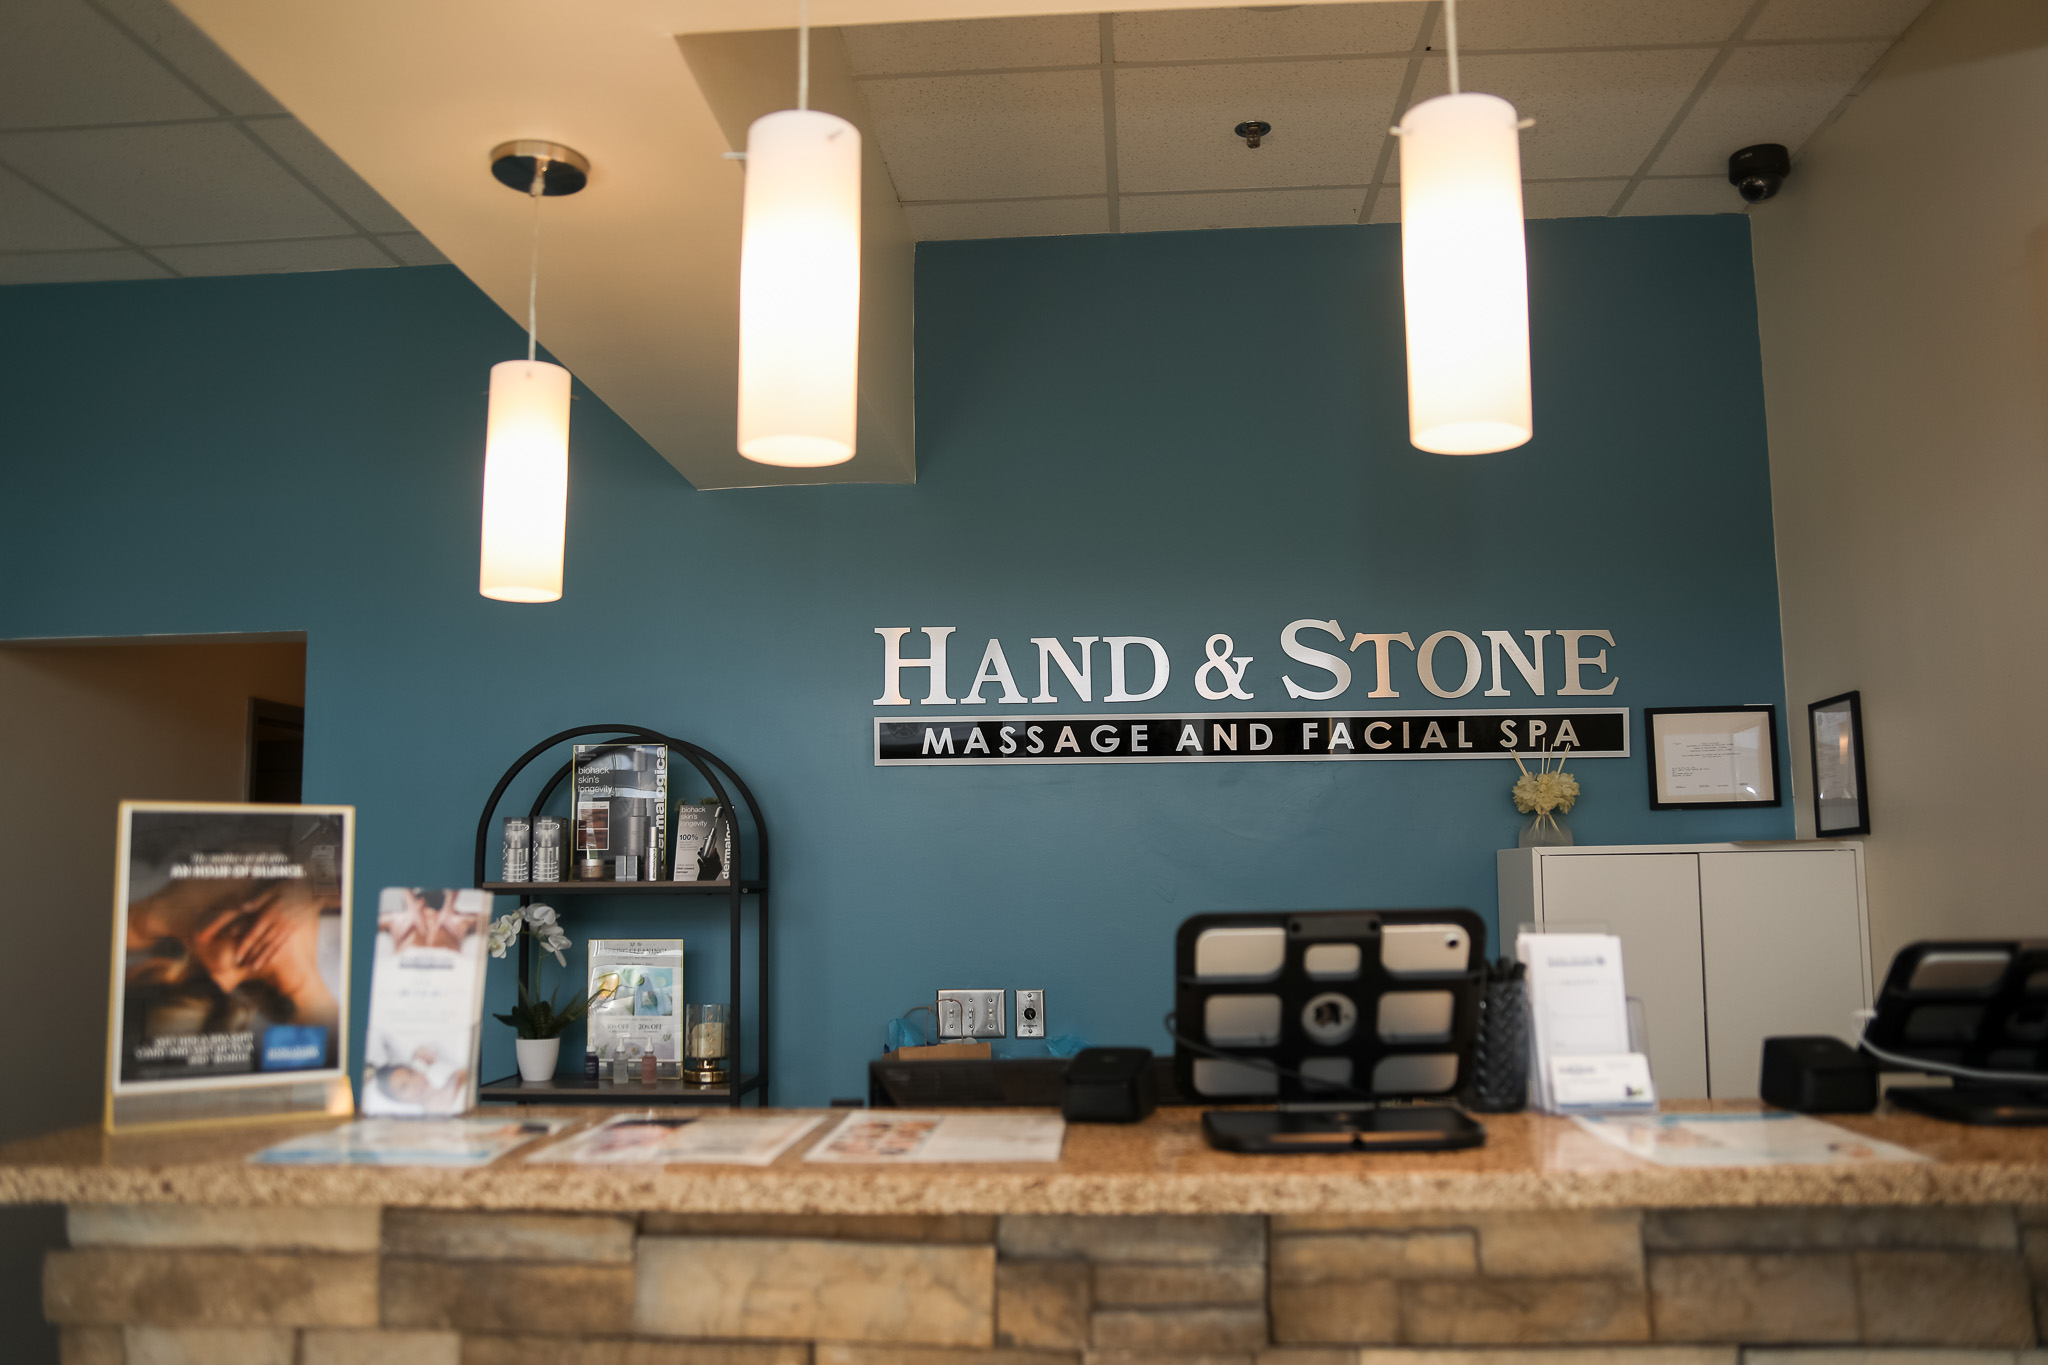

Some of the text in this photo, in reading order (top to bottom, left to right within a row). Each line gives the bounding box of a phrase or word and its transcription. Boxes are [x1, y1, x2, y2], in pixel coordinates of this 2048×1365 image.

[873, 619, 1619, 706] HAND & STONE
[921, 718, 1581, 755] MASSAGE AND FACIAL SPA
[578, 766, 610, 775] biohack
[578, 775, 600, 784] skin's
[577, 785, 613, 795] longevity
[680, 820, 708, 828] longevity
